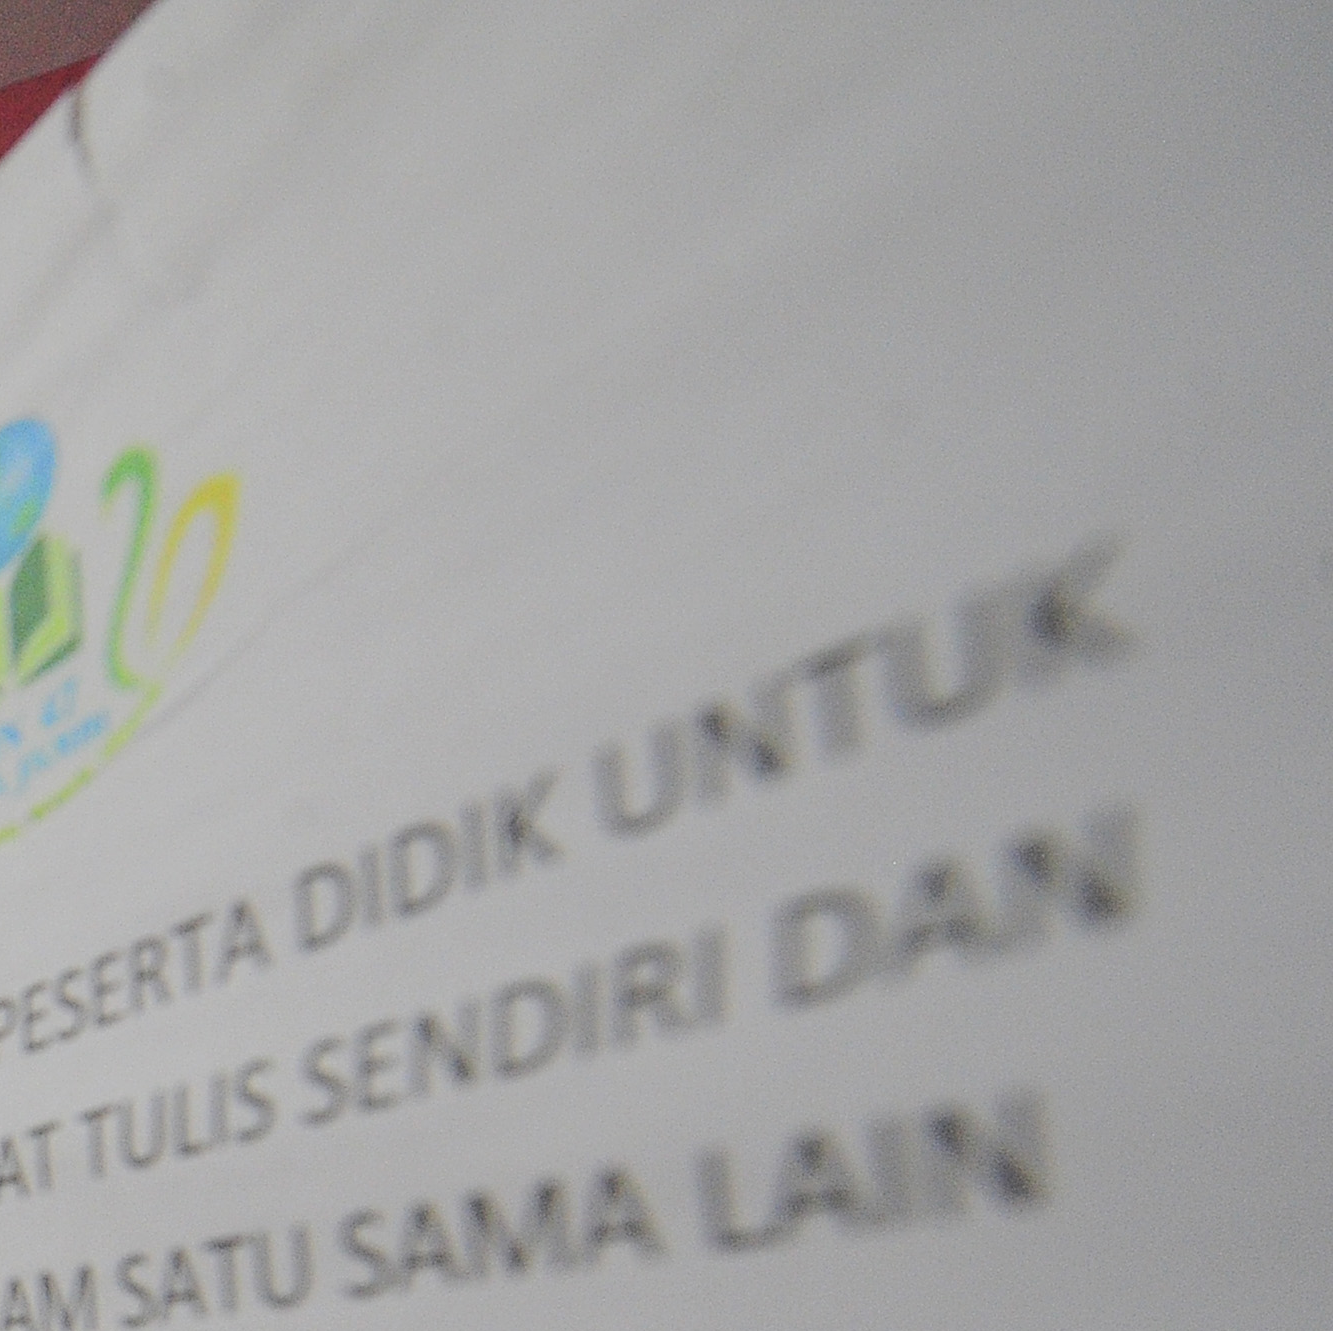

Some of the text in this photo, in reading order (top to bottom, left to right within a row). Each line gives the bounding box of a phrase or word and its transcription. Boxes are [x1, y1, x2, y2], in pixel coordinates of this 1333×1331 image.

[293, 767, 561, 953] DIDIK
[592, 540, 1138, 838] UNTUK
[78, 1057, 276, 1177] TULIS
[298, 922, 729, 1129] SENDIRI
[767, 802, 1147, 1013] DAN
[117, 1223, 315, 1331] SATU
[338, 1163, 669, 1303] SAMA
[692, 1080, 1053, 1256] LAIN
